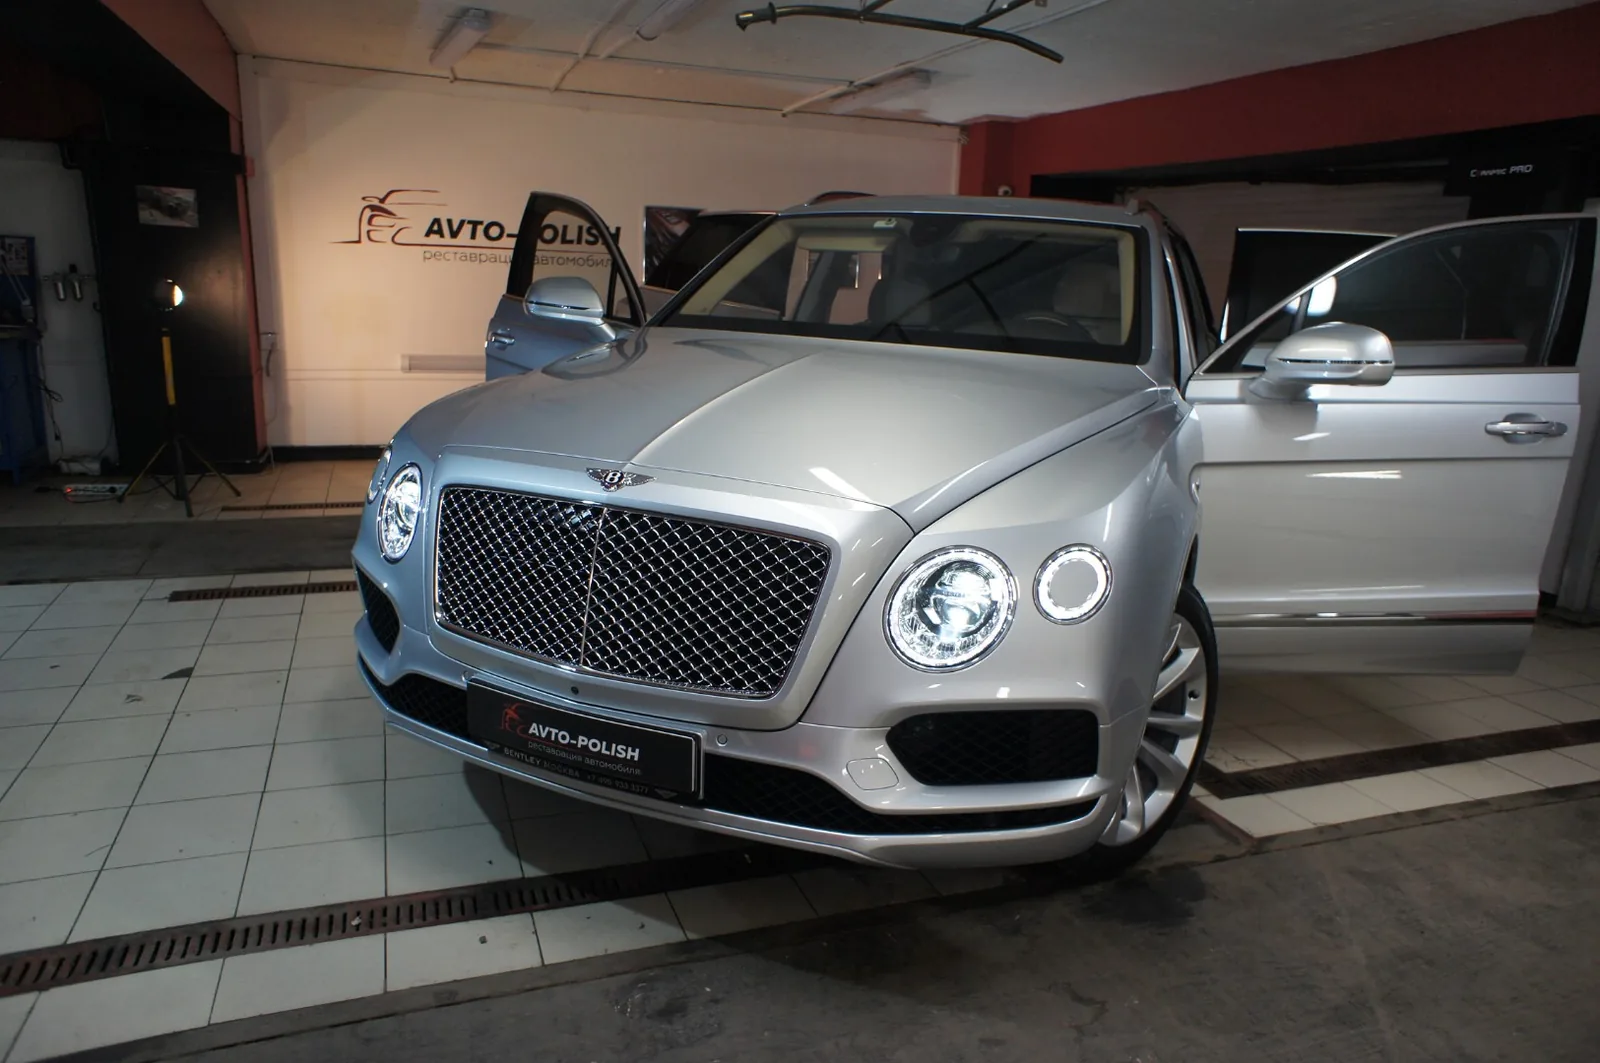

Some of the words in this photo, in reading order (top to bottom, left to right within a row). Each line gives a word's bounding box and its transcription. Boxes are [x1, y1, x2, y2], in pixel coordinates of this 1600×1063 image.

[1470, 168, 1507, 178] CRAMIC
[1509, 164, 1533, 174] PRO
[424, 217, 621, 247] AVTO-OLISH
[423, 250, 512, 265] реставрац
[533, 254, 613, 268] автомобил
[528, 722, 640, 761] AVTO-POLISH
[504, 747, 543, 767] BENTLEY
[528, 741, 583, 763] реставрация
[584, 755, 642, 776] автомобиля
